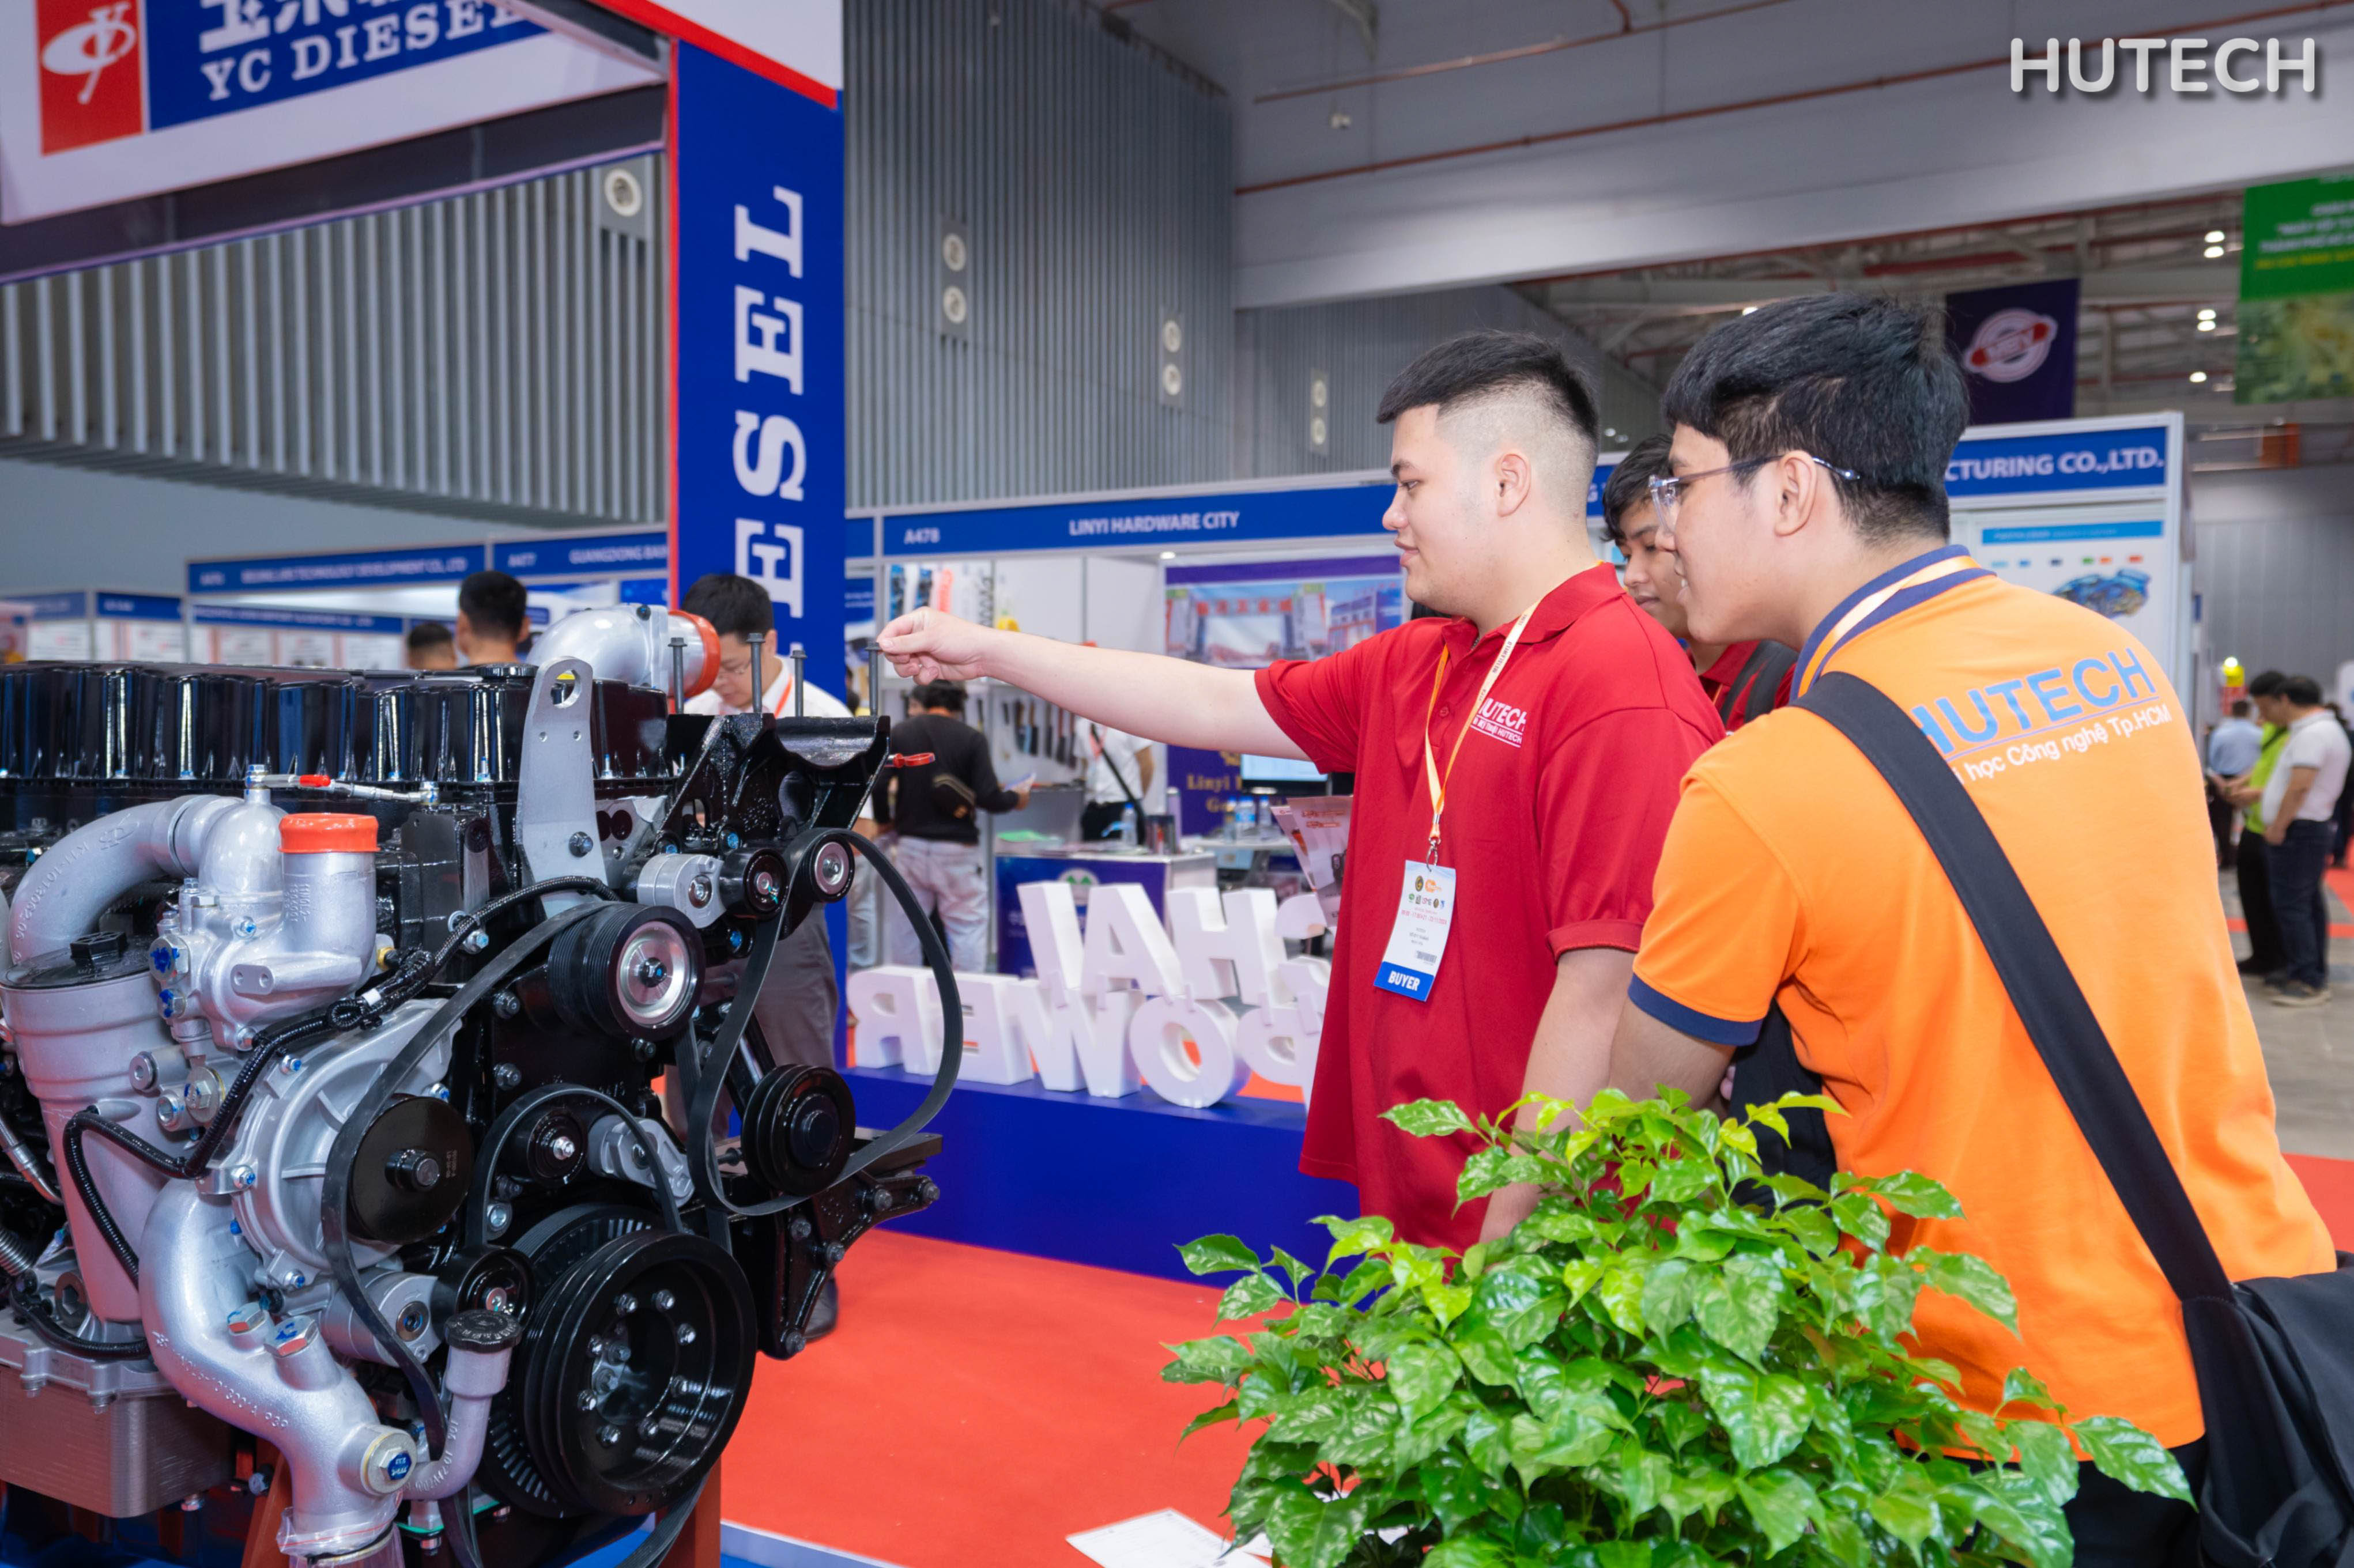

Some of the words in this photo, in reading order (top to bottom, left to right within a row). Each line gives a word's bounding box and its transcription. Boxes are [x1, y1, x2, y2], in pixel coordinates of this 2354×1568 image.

[200, 48, 272, 101] YC
[733, 186, 806, 619] ESEL
[1069, 519, 1109, 536] LINYI
[1110, 512, 1201, 534] HARDWARE
[1202, 511, 1240, 529] CITY
[1498, 728, 1523, 744] HUTECH
[1965, 755, 2005, 782] học
[2006, 739, 2060, 766] Công
[2062, 721, 2109, 754] nghệ
[2107, 704, 2172, 738] Tp.HCM
[1388, 970, 1420, 992] BUYER
